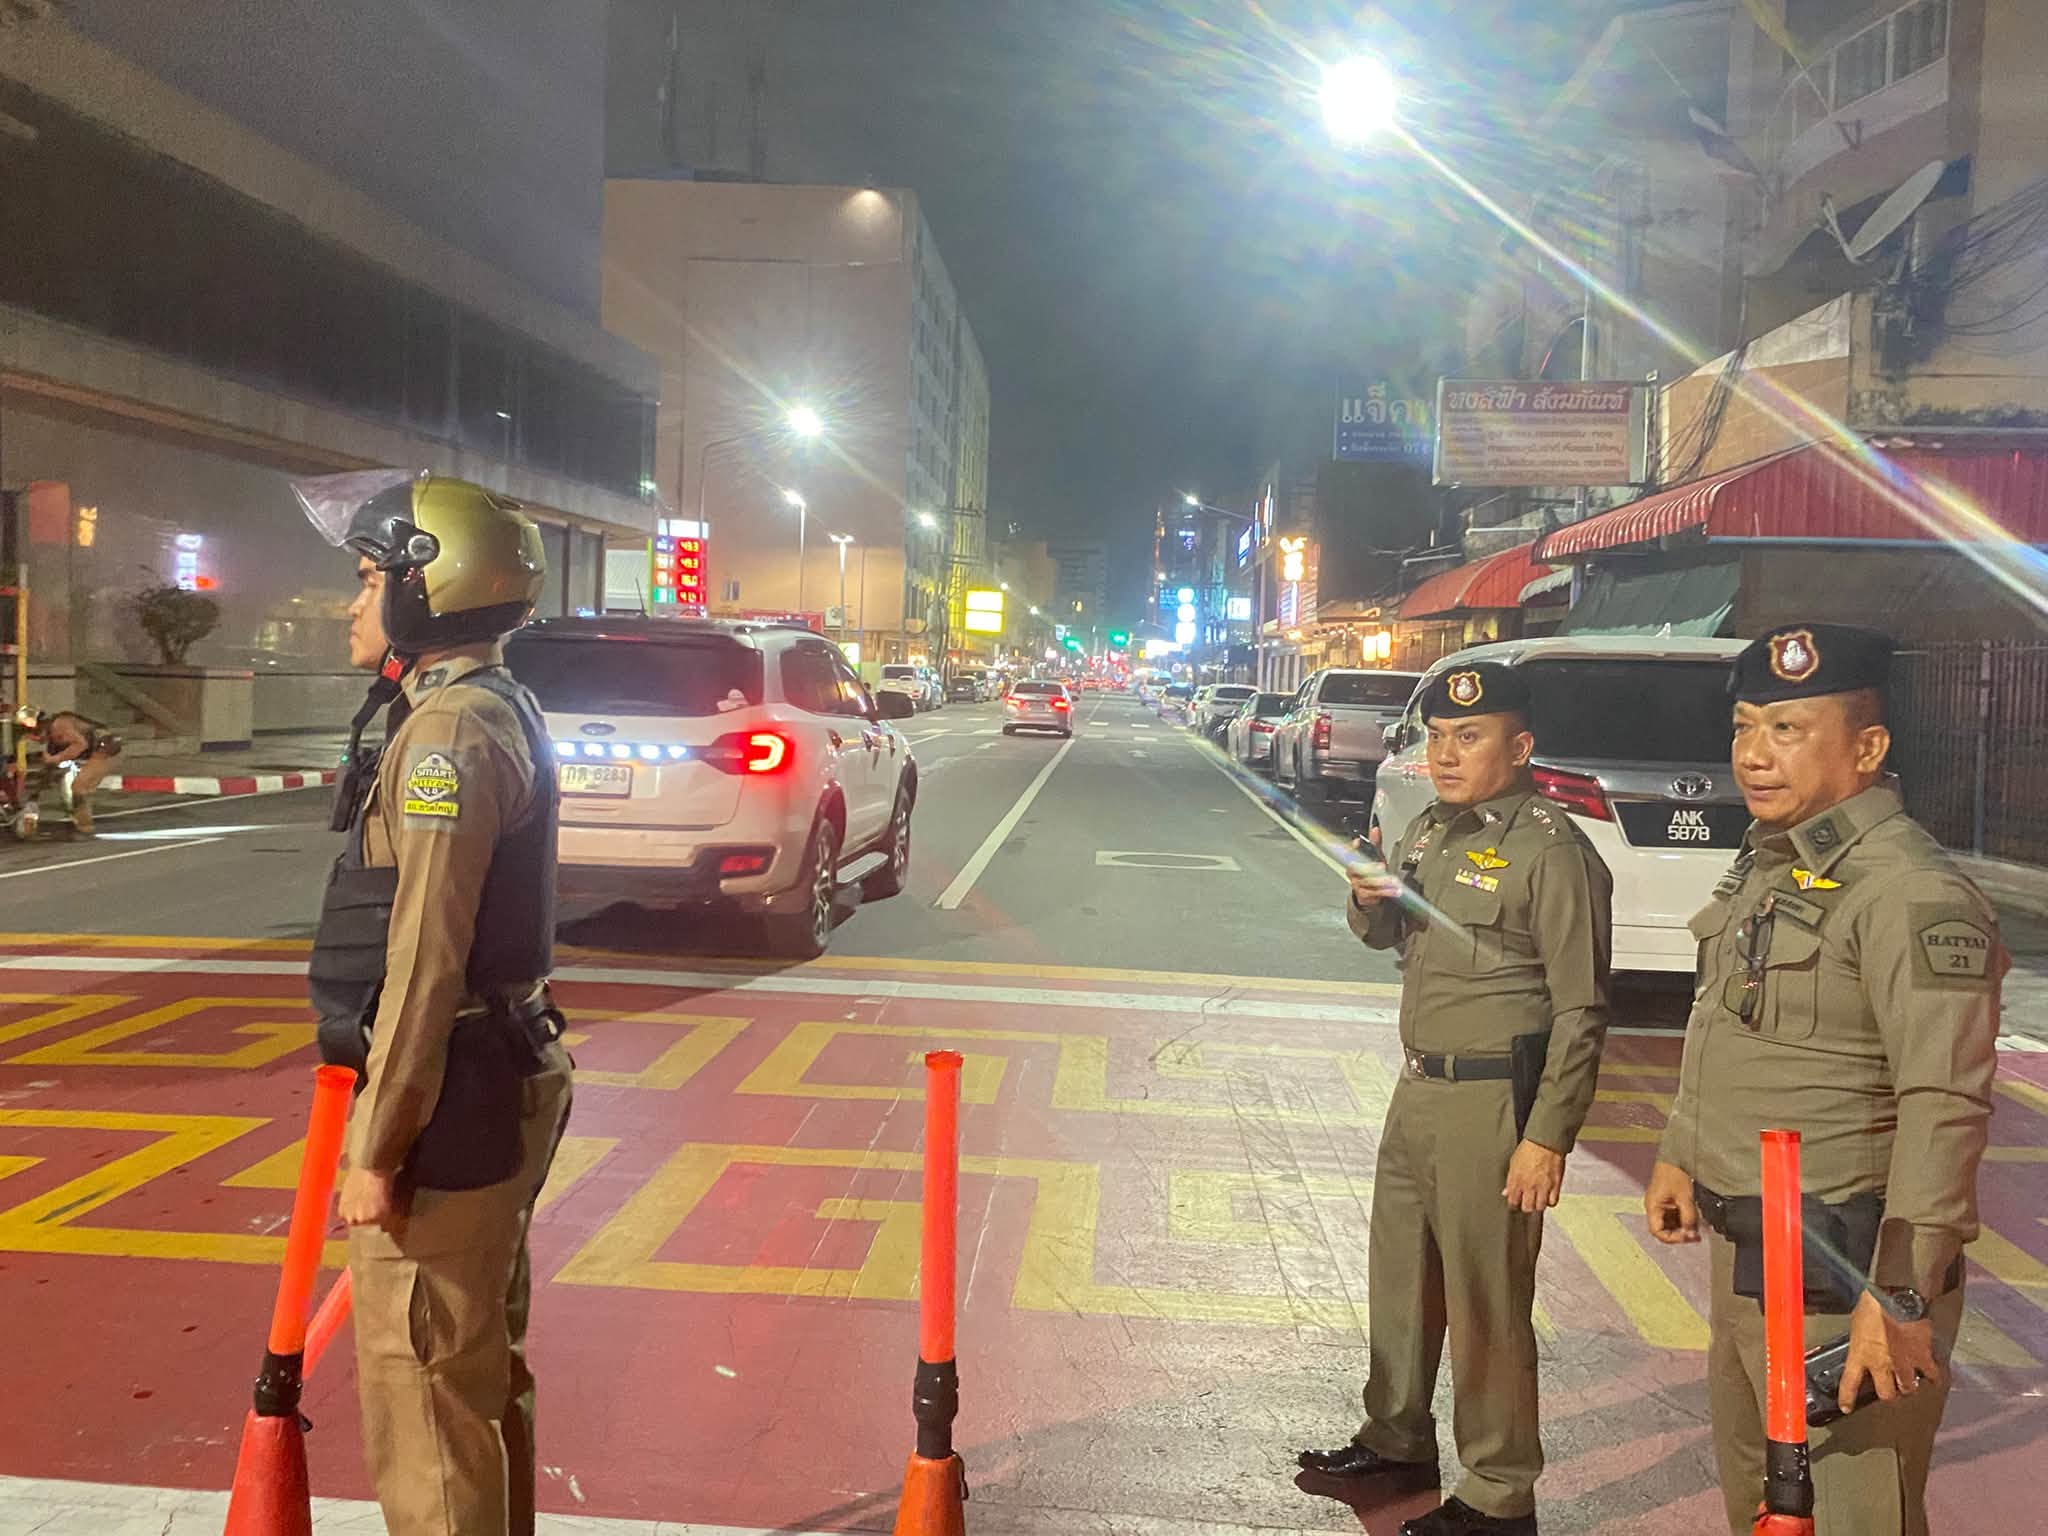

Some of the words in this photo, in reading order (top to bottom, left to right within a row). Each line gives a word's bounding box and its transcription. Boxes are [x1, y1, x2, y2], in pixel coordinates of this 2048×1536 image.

[1671, 810, 1705, 825] ANK
[1667, 825, 1710, 841] 5878
[1927, 935, 1986, 950] HATYAI
[1949, 954, 1971, 969] 21
